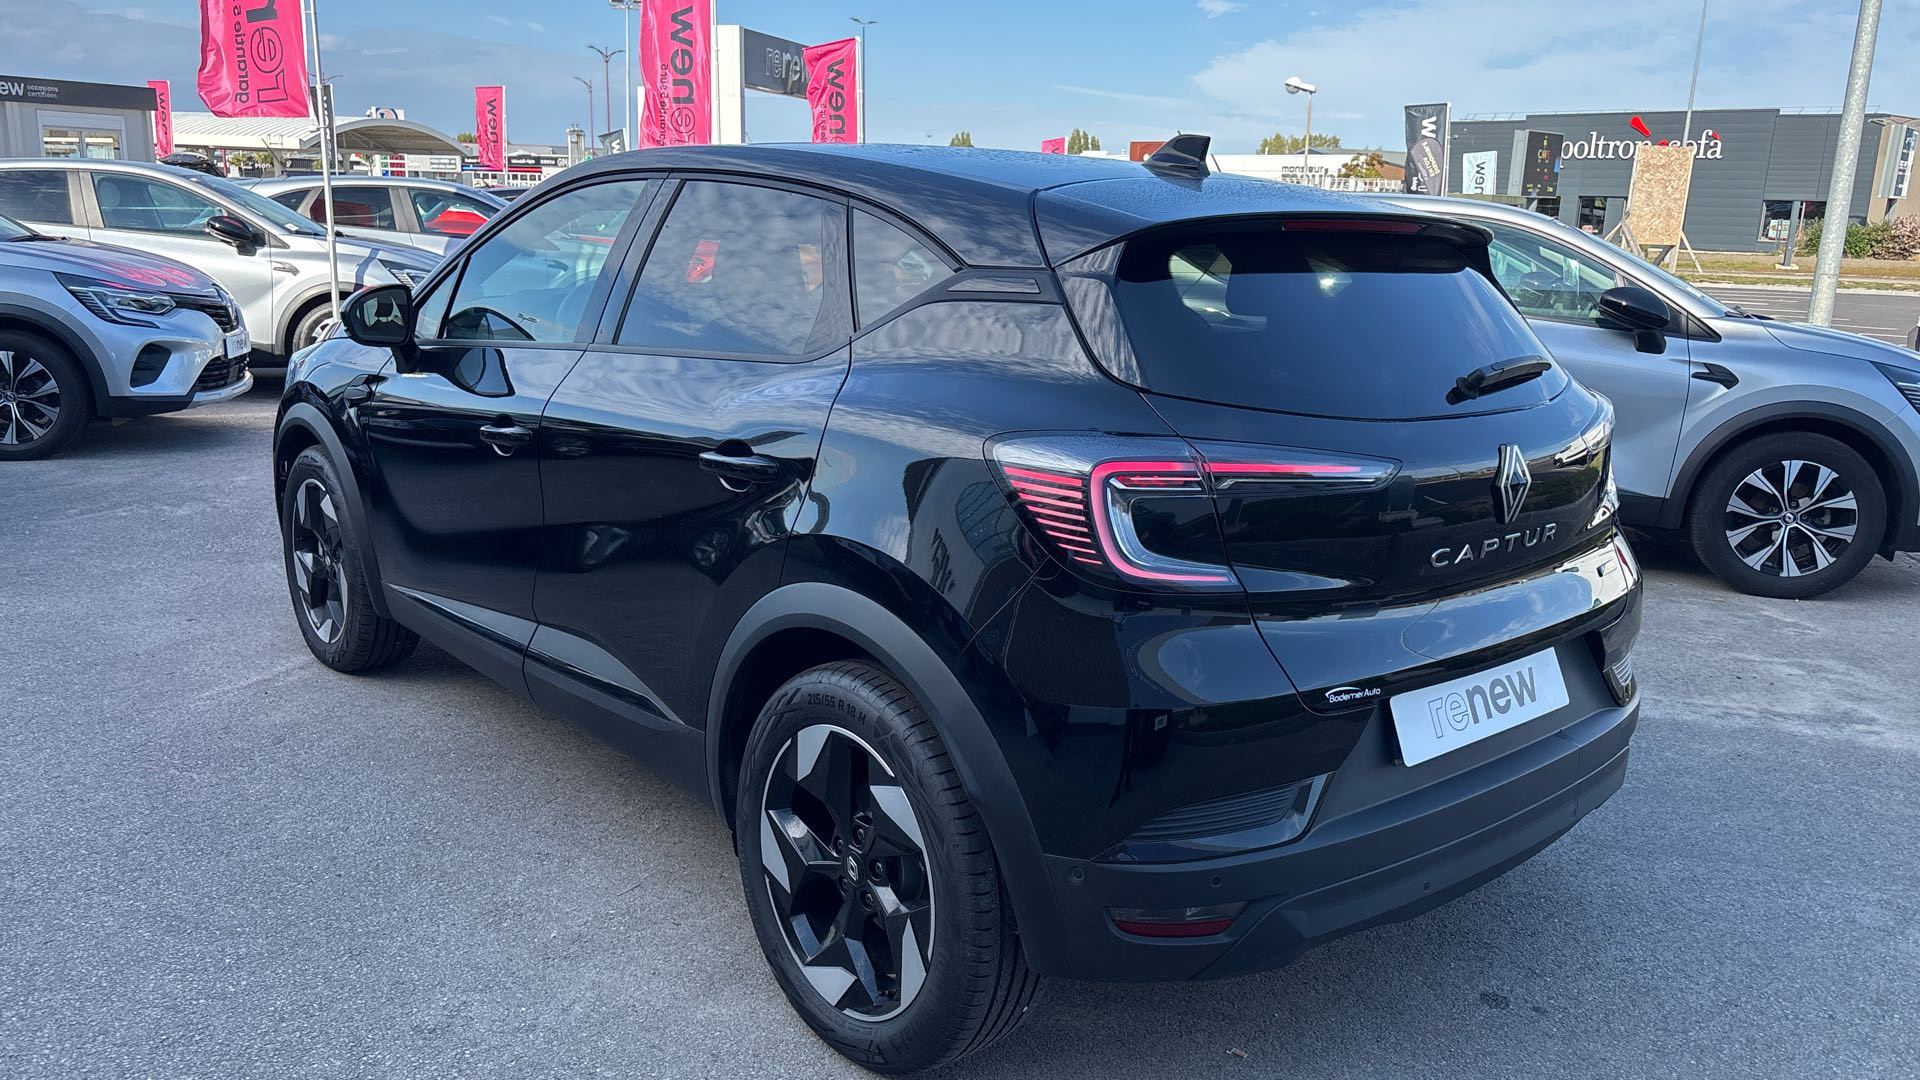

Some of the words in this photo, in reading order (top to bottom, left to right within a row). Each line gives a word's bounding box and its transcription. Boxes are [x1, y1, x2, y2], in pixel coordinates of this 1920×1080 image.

[27, 84, 59, 93] occasions
[1430, 523, 1557, 568] CAPTUR
[838, 699, 845, 712] R
[846, 703, 857, 718] 18
[857, 711, 867, 725] H
[1427, 666, 1537, 740] renew
